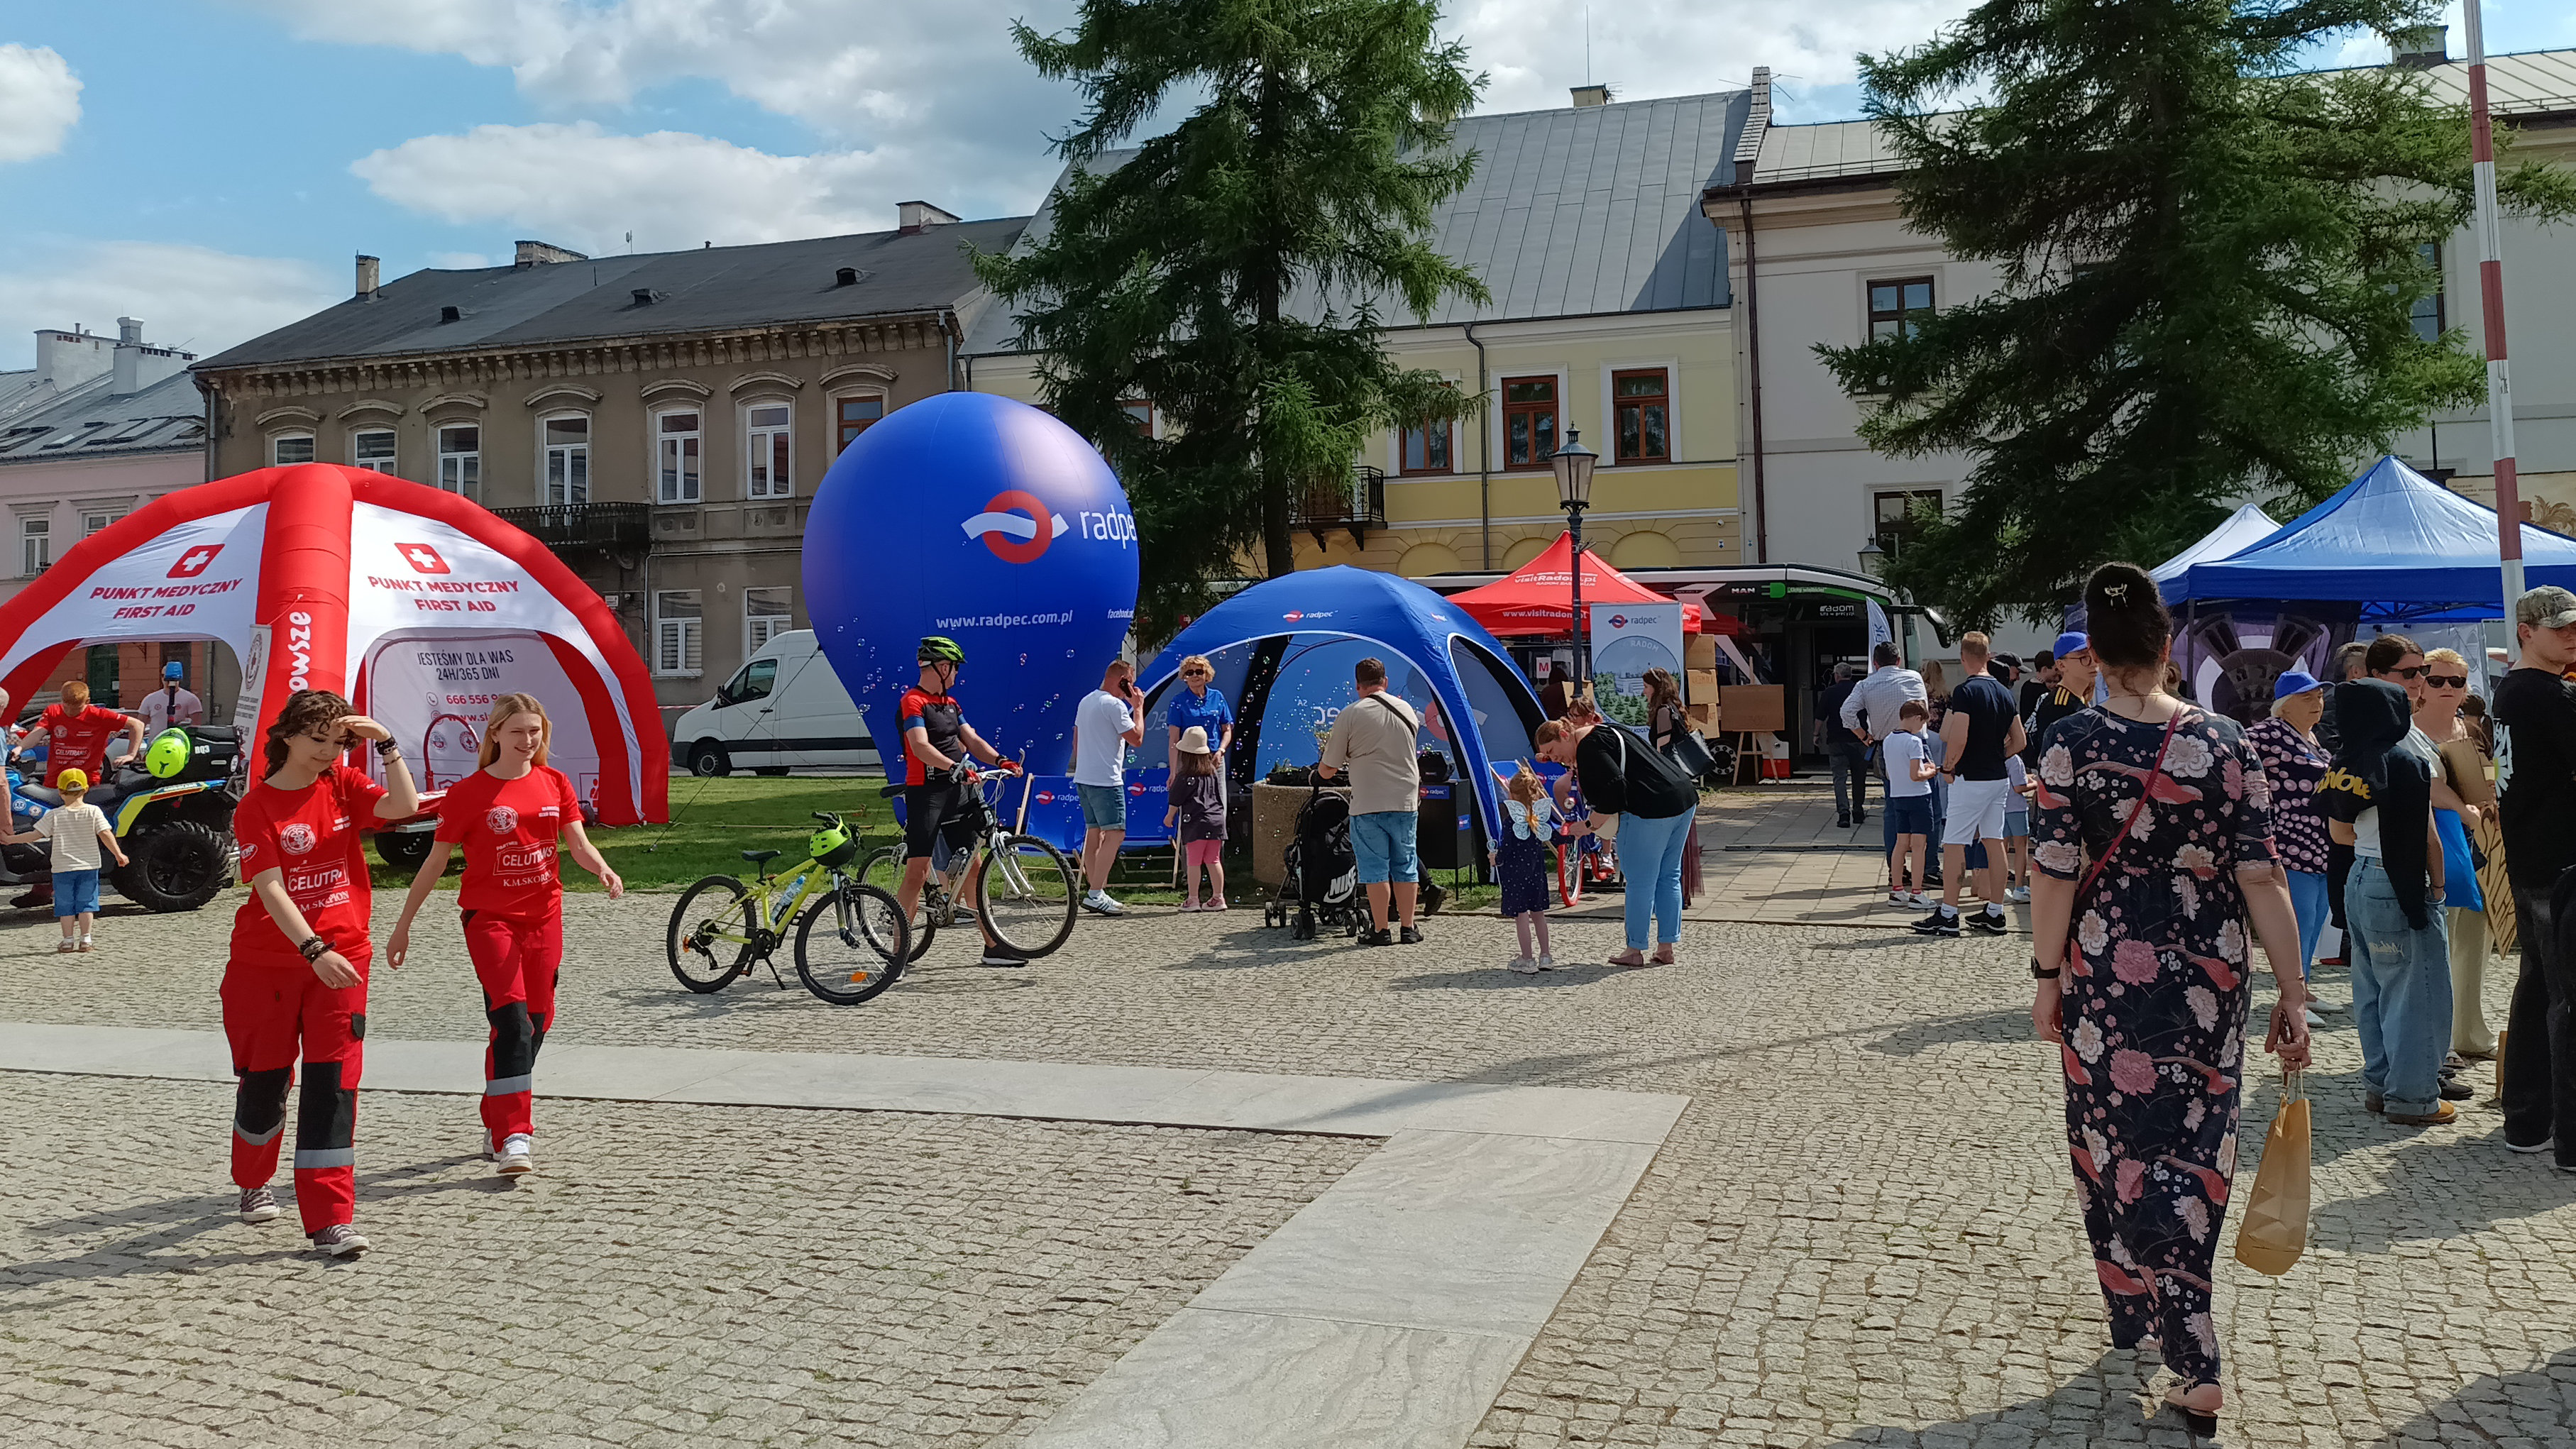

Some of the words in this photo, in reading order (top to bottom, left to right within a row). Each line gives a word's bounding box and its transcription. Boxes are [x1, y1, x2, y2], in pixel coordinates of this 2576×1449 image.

[1079, 503, 1138, 549] radpe
[368, 575, 424, 593] PUNKT
[426, 580, 519, 593] MEDYCZNY
[1514, 573, 1597, 583] visitRado.pl
[89, 587, 153, 600] PUNKT
[151, 578, 243, 599] MEDYCZNY
[113, 605, 165, 619] FIRST
[163, 603, 196, 617] AID
[414, 599, 462, 612] FIRST
[466, 600, 497, 612] AID
[935, 610, 1074, 629] www.radpec.com.pl
[1306, 610, 1333, 619] radpec
[1502, 609, 1587, 619] www.visitradompl
[1631, 616, 1657, 625] radpec
[1630, 639, 1659, 652] RADOM
[287, 611, 312, 696] owsze
[417, 649, 465, 666] JESTEŚMY
[466, 651, 487, 666] DLA
[488, 649, 514, 664] WAS
[436, 667, 480, 681] 24H/365
[481, 666, 500, 680] DNI
[1539, 662, 1549, 672] M
[446, 695, 467, 705] 666
[468, 694, 490, 705] 556
[1148, 784, 1169, 793] radpe
[1057, 793, 1079, 802] radpe
[287, 868, 343, 892] CELUTR
[1328, 864, 1356, 896] NIKE
